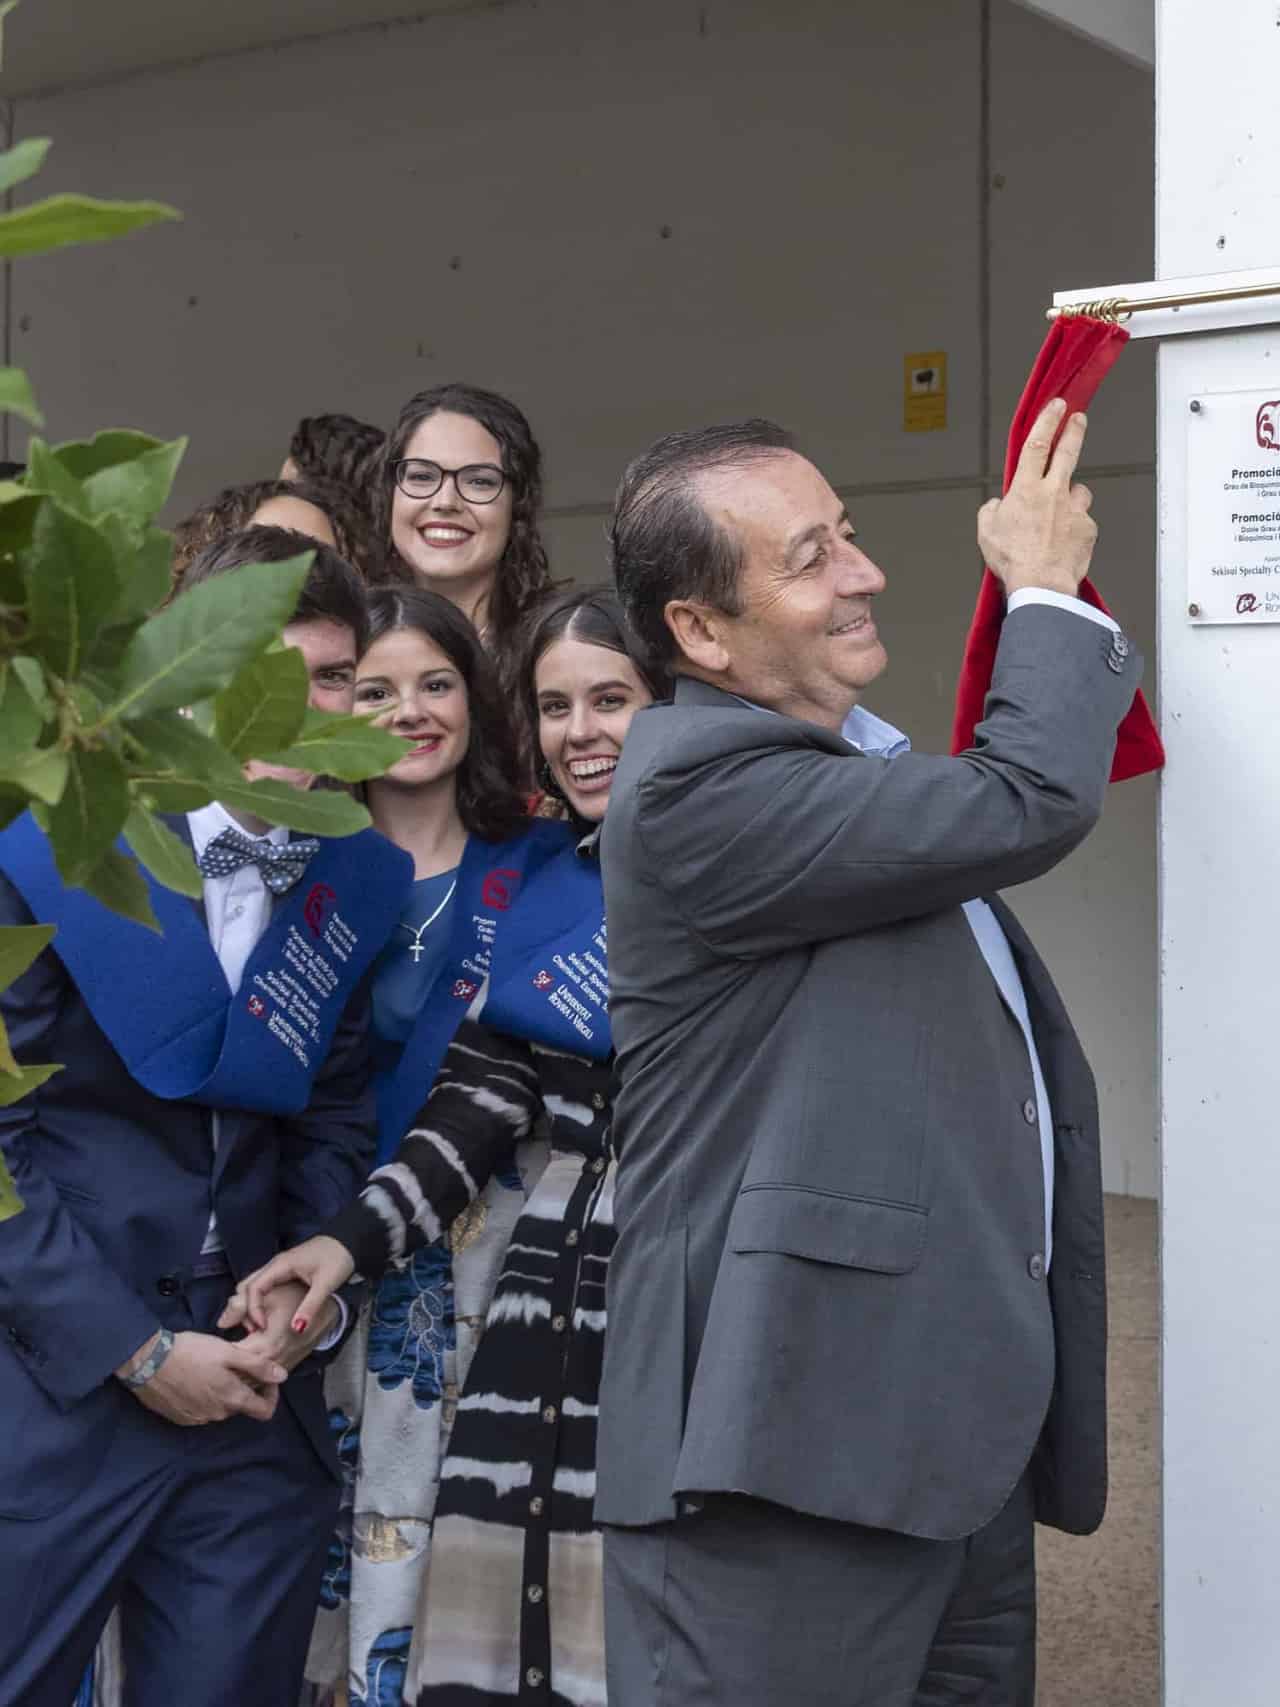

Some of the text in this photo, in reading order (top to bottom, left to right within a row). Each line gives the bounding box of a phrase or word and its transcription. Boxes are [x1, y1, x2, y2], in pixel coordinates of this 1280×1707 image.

[1231, 466, 1280, 479] Promoció
[1231, 511, 1280, 524] Promoció
[1239, 564, 1272, 577] Specialty
